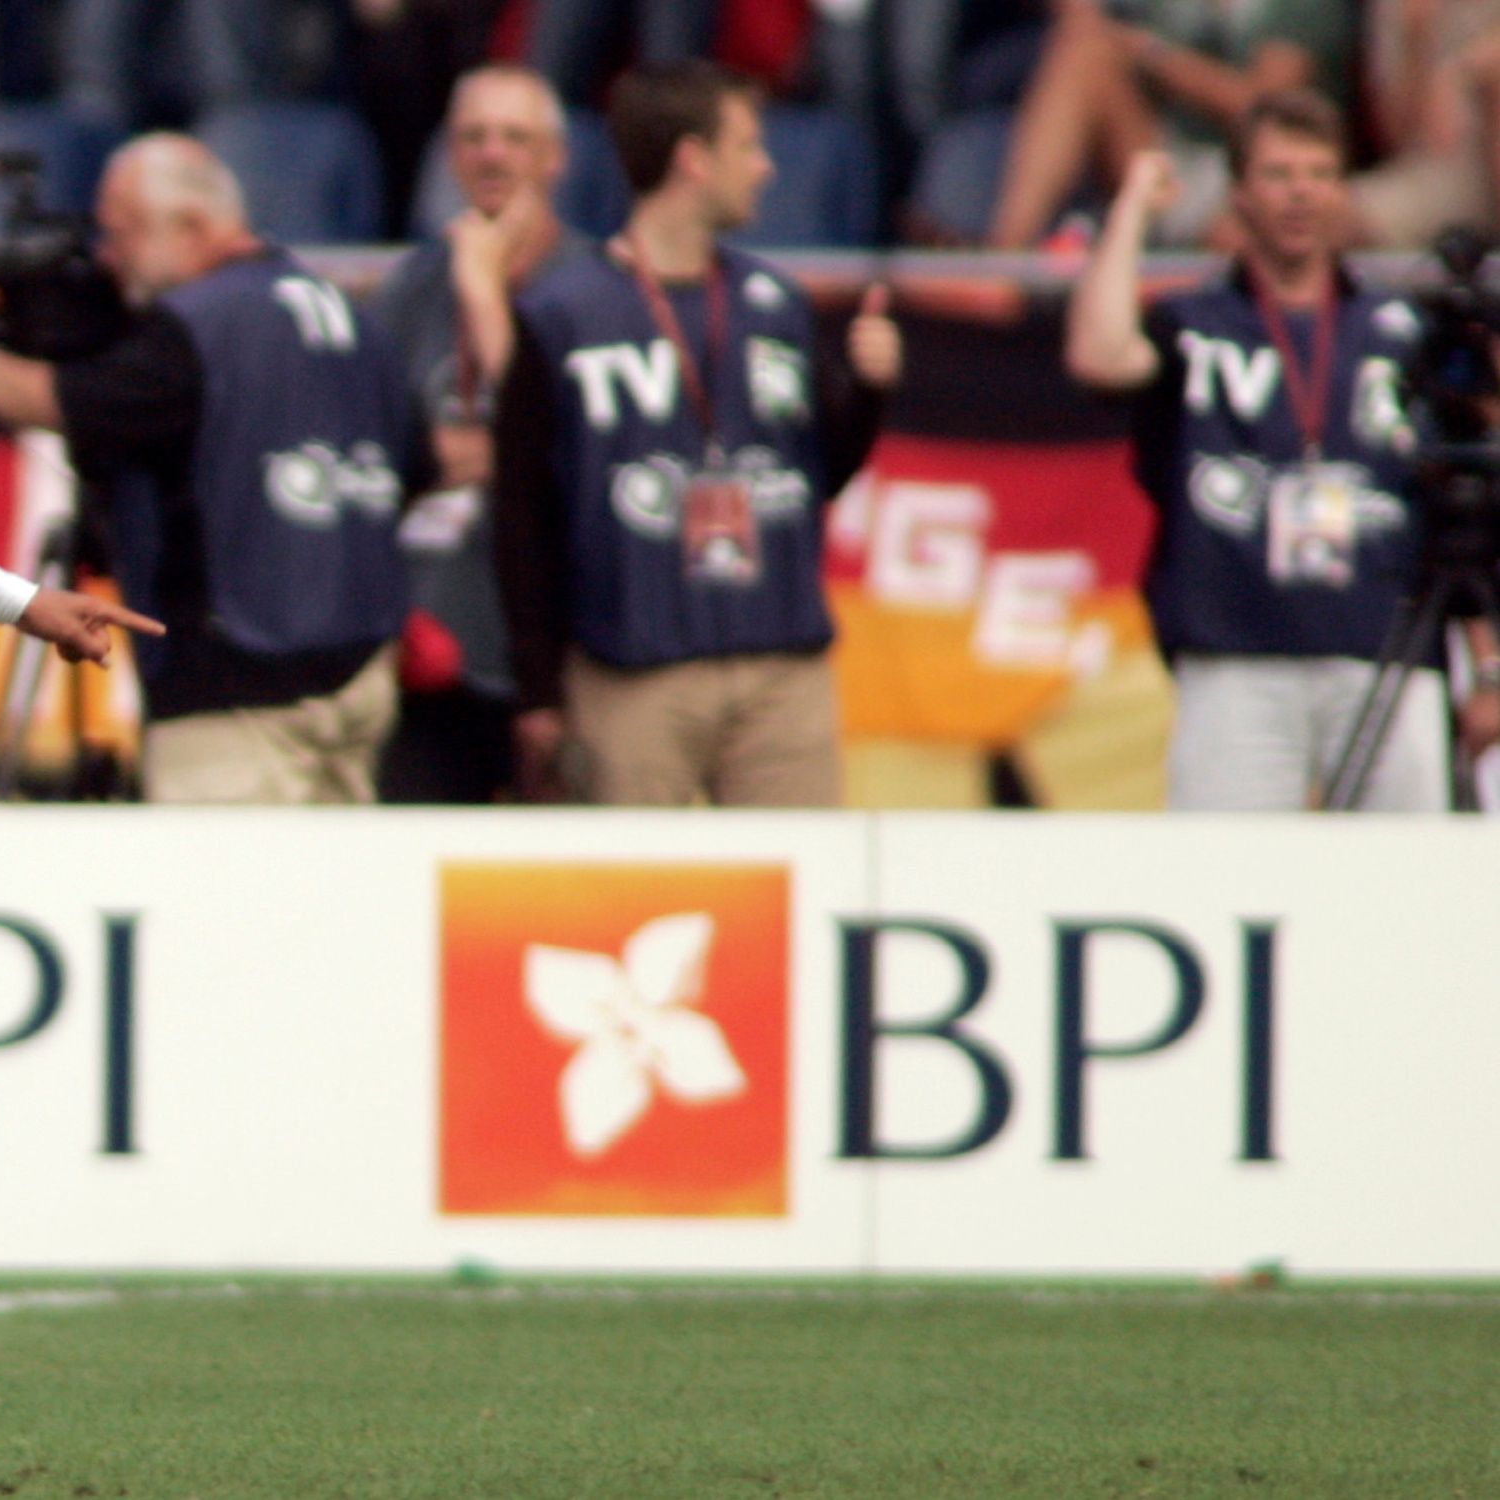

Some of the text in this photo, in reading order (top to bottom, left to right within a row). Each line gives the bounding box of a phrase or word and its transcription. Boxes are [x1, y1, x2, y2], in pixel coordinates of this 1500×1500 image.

[565, 337, 678, 430] TV
[1177, 328, 1280, 417] TV
[832, 914, 1282, 1161] BPI
